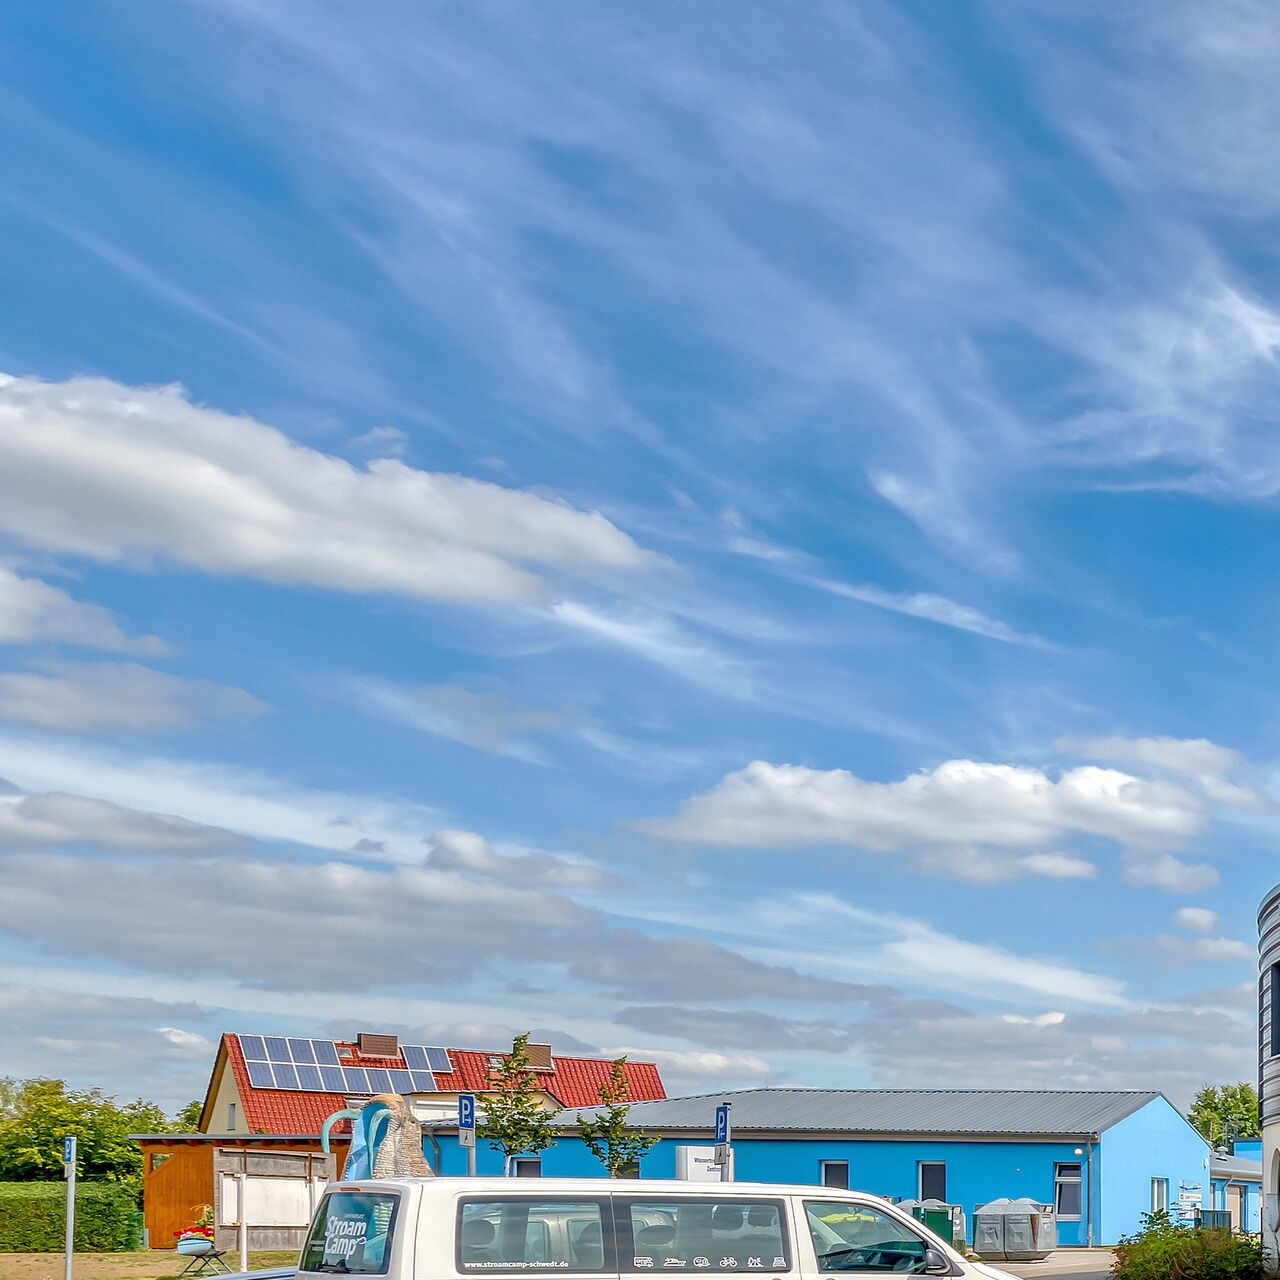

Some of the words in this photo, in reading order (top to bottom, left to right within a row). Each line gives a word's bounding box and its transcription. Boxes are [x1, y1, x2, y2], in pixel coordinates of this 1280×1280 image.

[462, 1099, 471, 1124] P
[718, 1111, 725, 1139] P
[324, 1215, 367, 1237] Stroam
[324, 1234, 358, 1260] Camp
[464, 1260, 569, 1269] www.stroamcamp-schwedt.de
